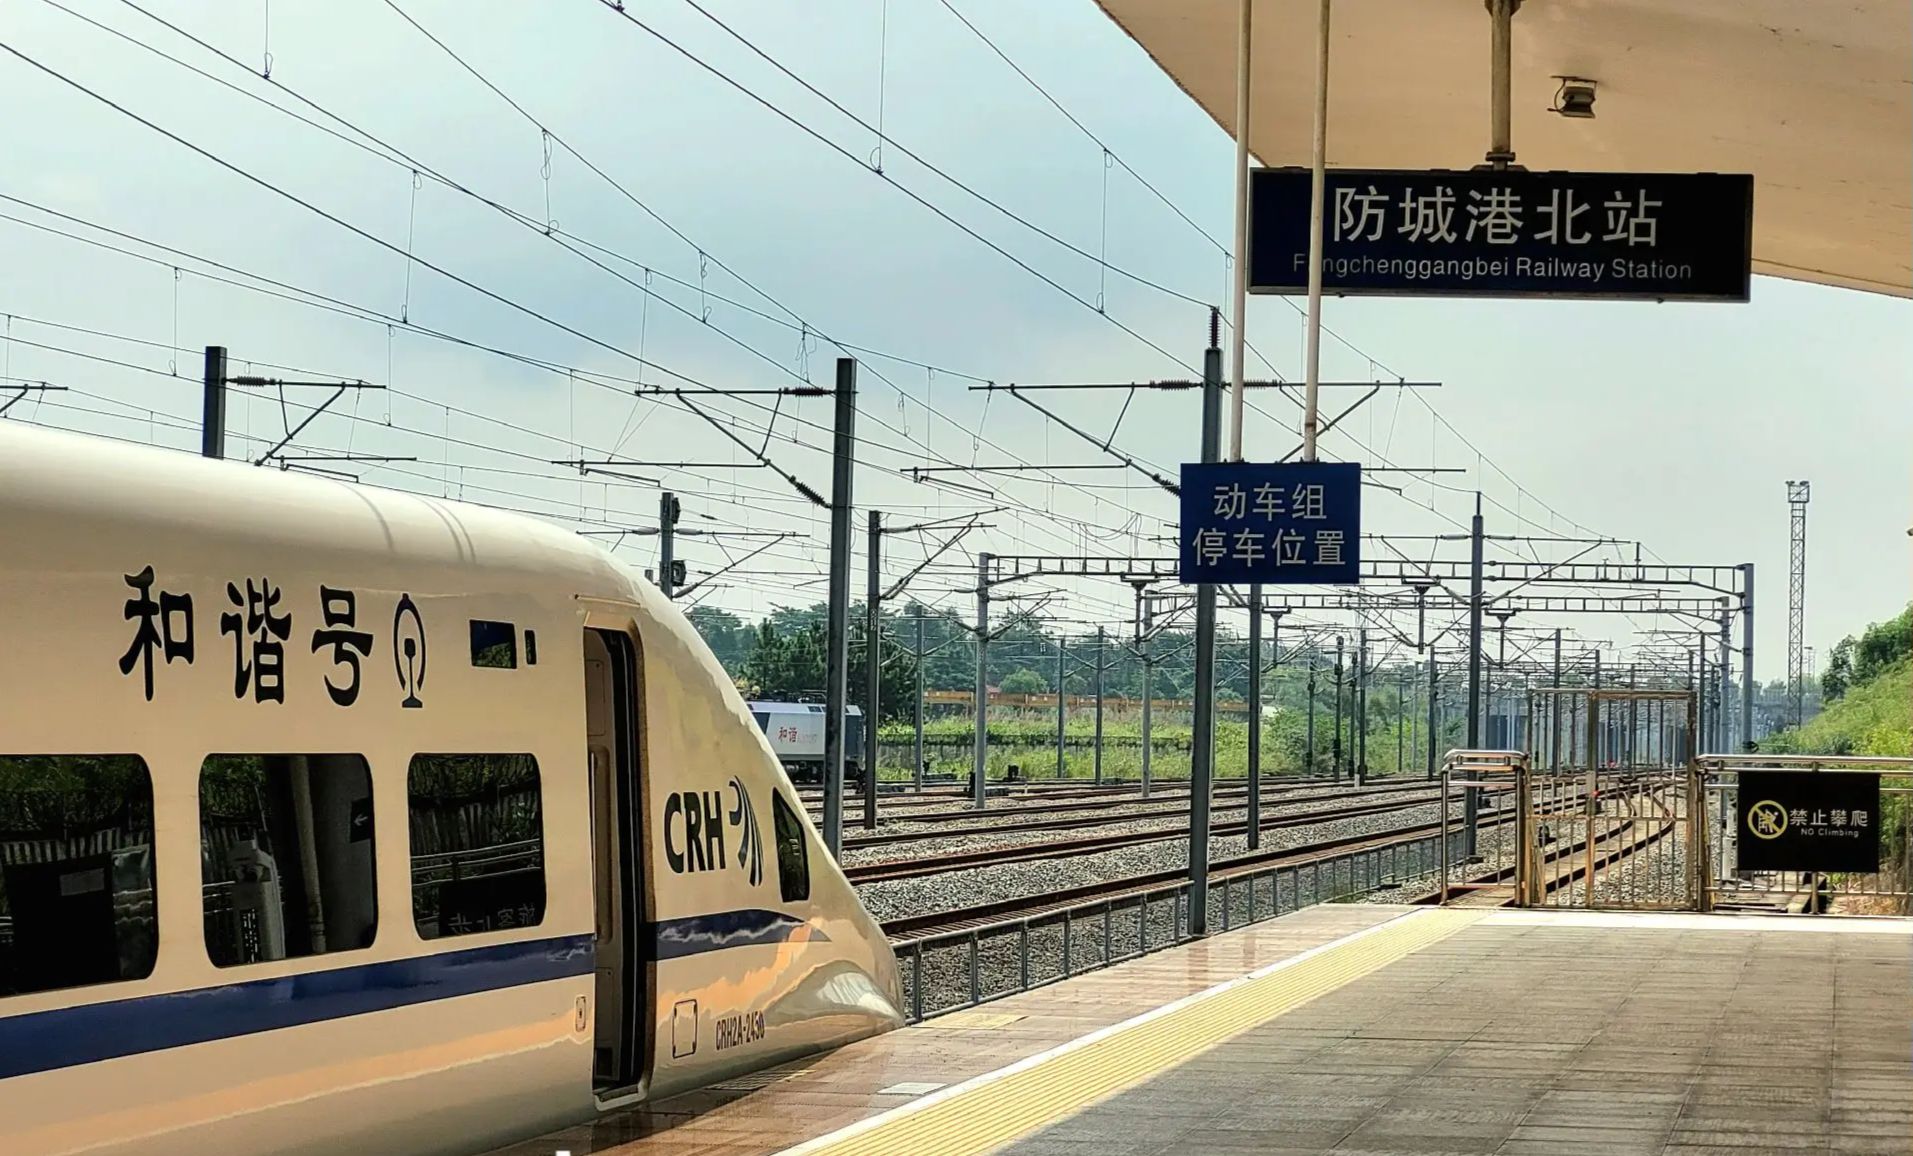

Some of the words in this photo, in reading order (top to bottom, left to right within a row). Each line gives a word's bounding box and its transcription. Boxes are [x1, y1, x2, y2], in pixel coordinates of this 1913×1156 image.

[1333, 185, 1663, 247] 防城港北站
[1293, 253, 1509, 280] Fngchenggangbei
[1516, 257, 1605, 283] Railway
[1611, 258, 1692, 279] Station
[1213, 482, 1327, 522] 动车组
[1192, 527, 1346, 568] 停车位置
[118, 565, 374, 707] 和谐号
[664, 790, 726, 874] CRH
[1789, 808, 1868, 827] 禁止攀爬
[1800, 827, 1815, 836] NO
[1817, 827, 1860, 838] Climbing
